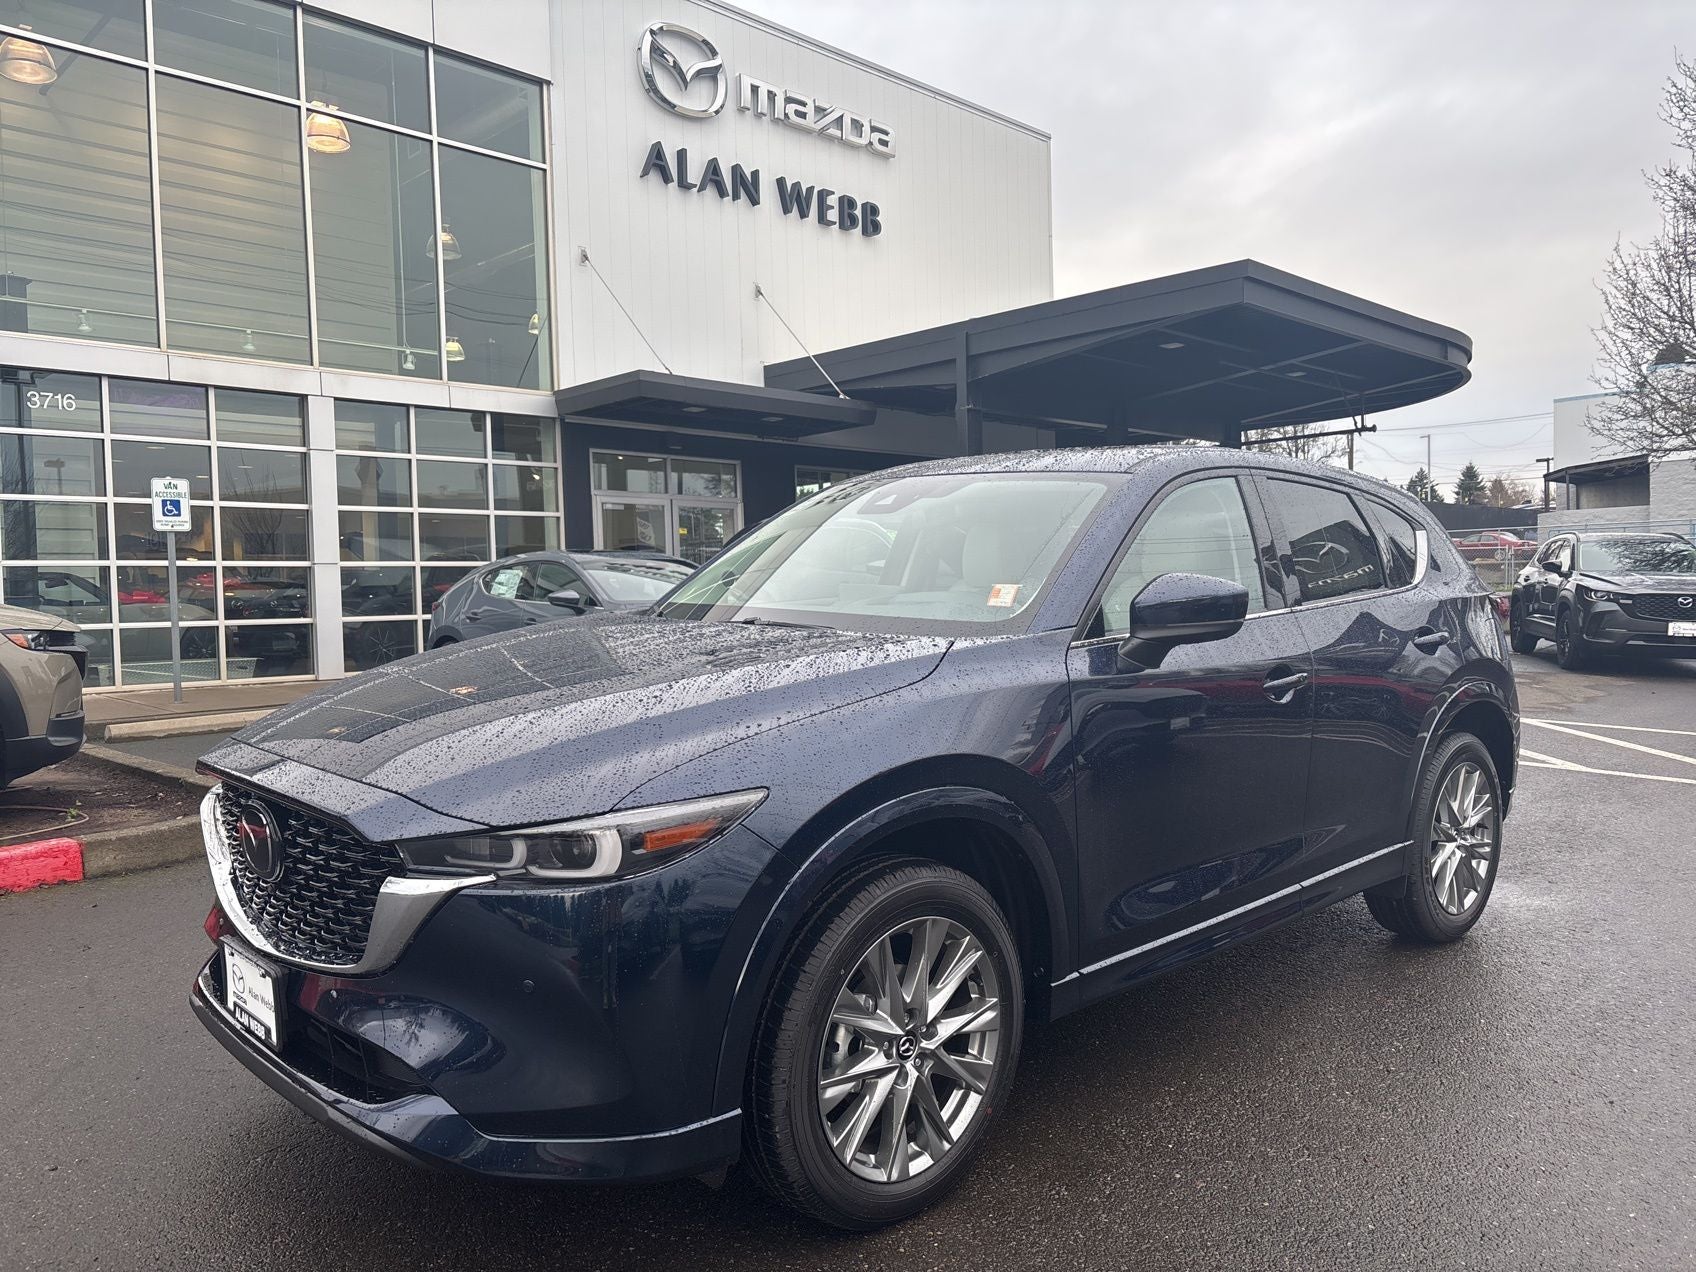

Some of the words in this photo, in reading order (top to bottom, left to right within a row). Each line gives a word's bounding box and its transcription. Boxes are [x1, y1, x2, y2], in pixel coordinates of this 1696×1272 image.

[737, 73, 896, 158] mazda
[640, 140, 761, 207] ALAN
[775, 175, 882, 238] WEBB
[26, 391, 76, 411] 3716
[154, 490, 188, 499] ACCESSIBLE
[163, 481, 178, 491] VAN
